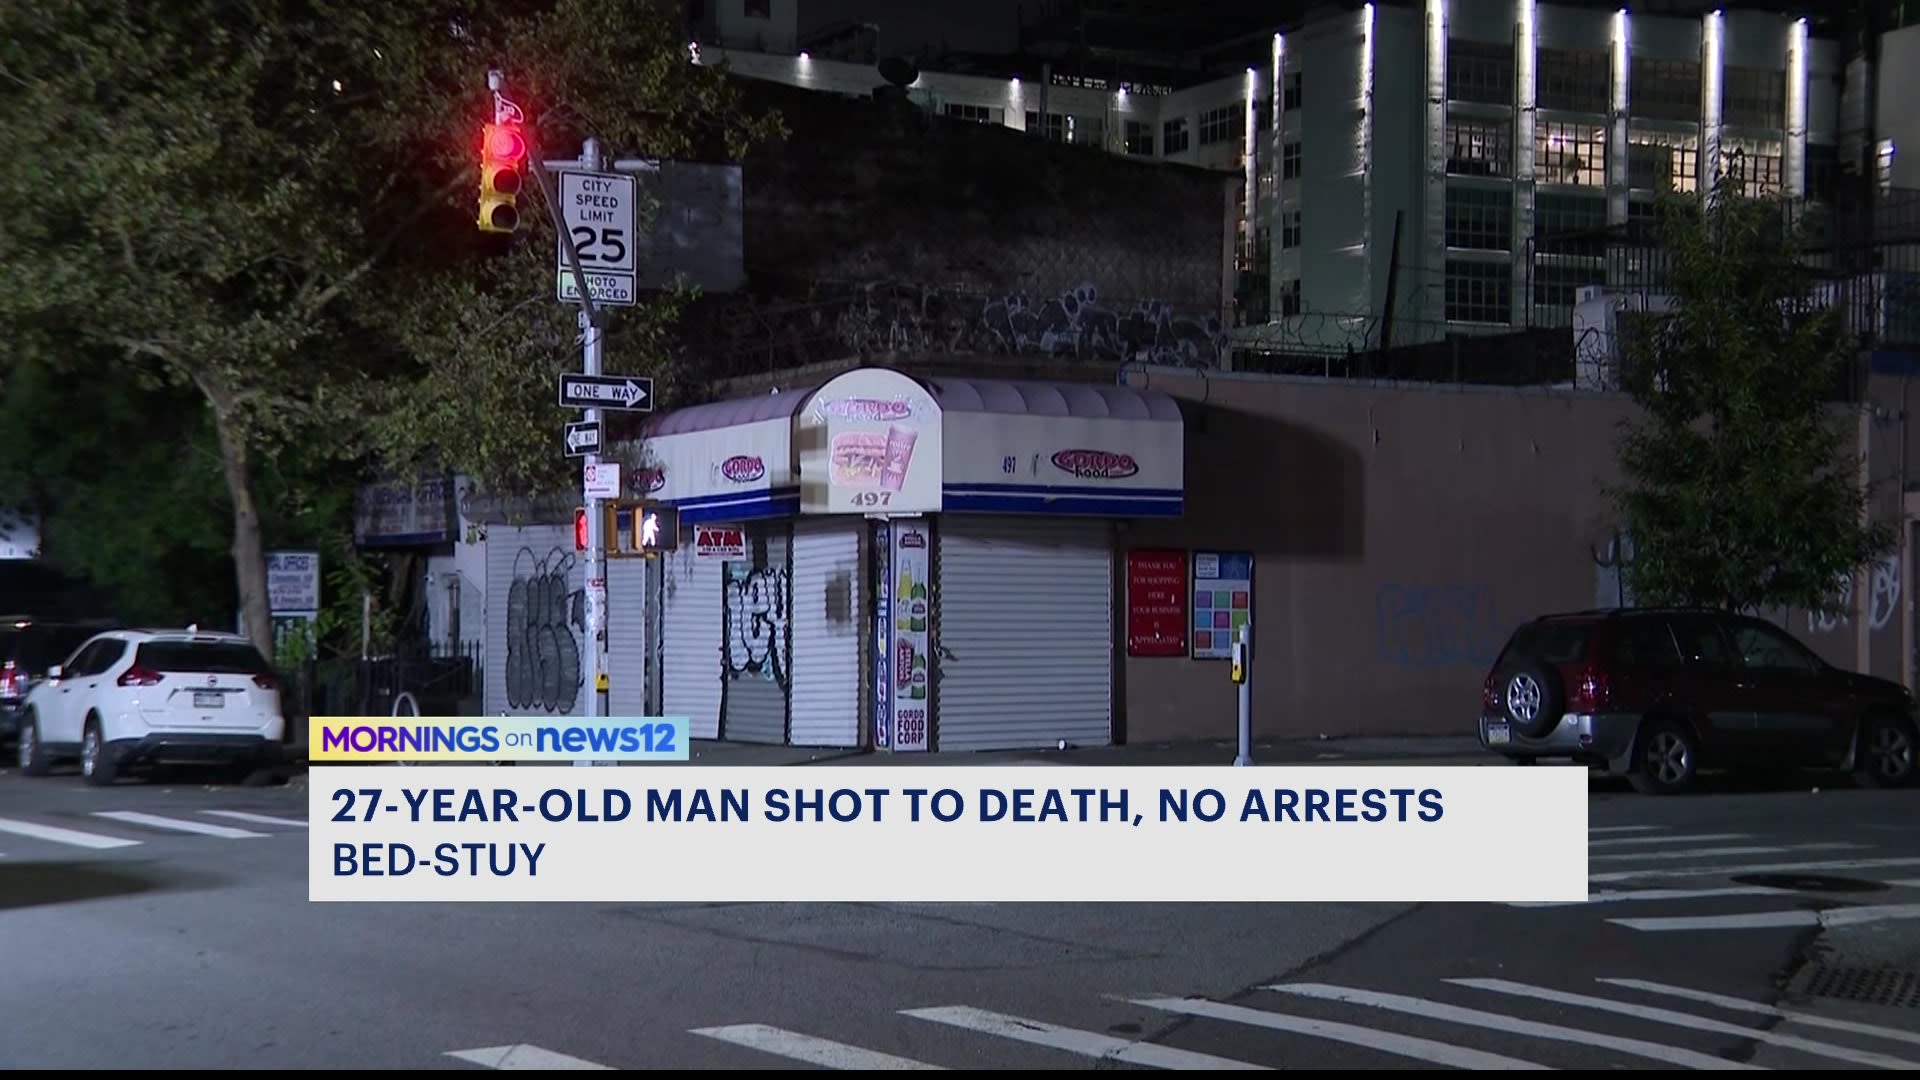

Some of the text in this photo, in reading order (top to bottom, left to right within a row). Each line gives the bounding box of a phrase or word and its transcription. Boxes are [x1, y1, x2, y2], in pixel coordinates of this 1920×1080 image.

[582, 180, 612, 193] CITY
[576, 194, 618, 208] SPEED
[580, 210, 614, 223] LIMIT
[572, 226, 626, 263] 25
[583, 276, 617, 288] HOTO
[566, 286, 628, 299] ENORCED
[573, 384, 638, 400] ONE WAY
[570, 432, 596, 446] ONE WAY
[725, 456, 763, 475] GORDO
[1002, 455, 1017, 474] 497
[1057, 450, 1133, 470] GORDO
[850, 491, 892, 506] 497
[697, 531, 743, 547] ATM
[1138, 561, 1177, 569] THANK YOU
[897, 709, 925, 719] GORDO
[897, 719, 925, 732] FOOD
[897, 732, 925, 745] CORP
